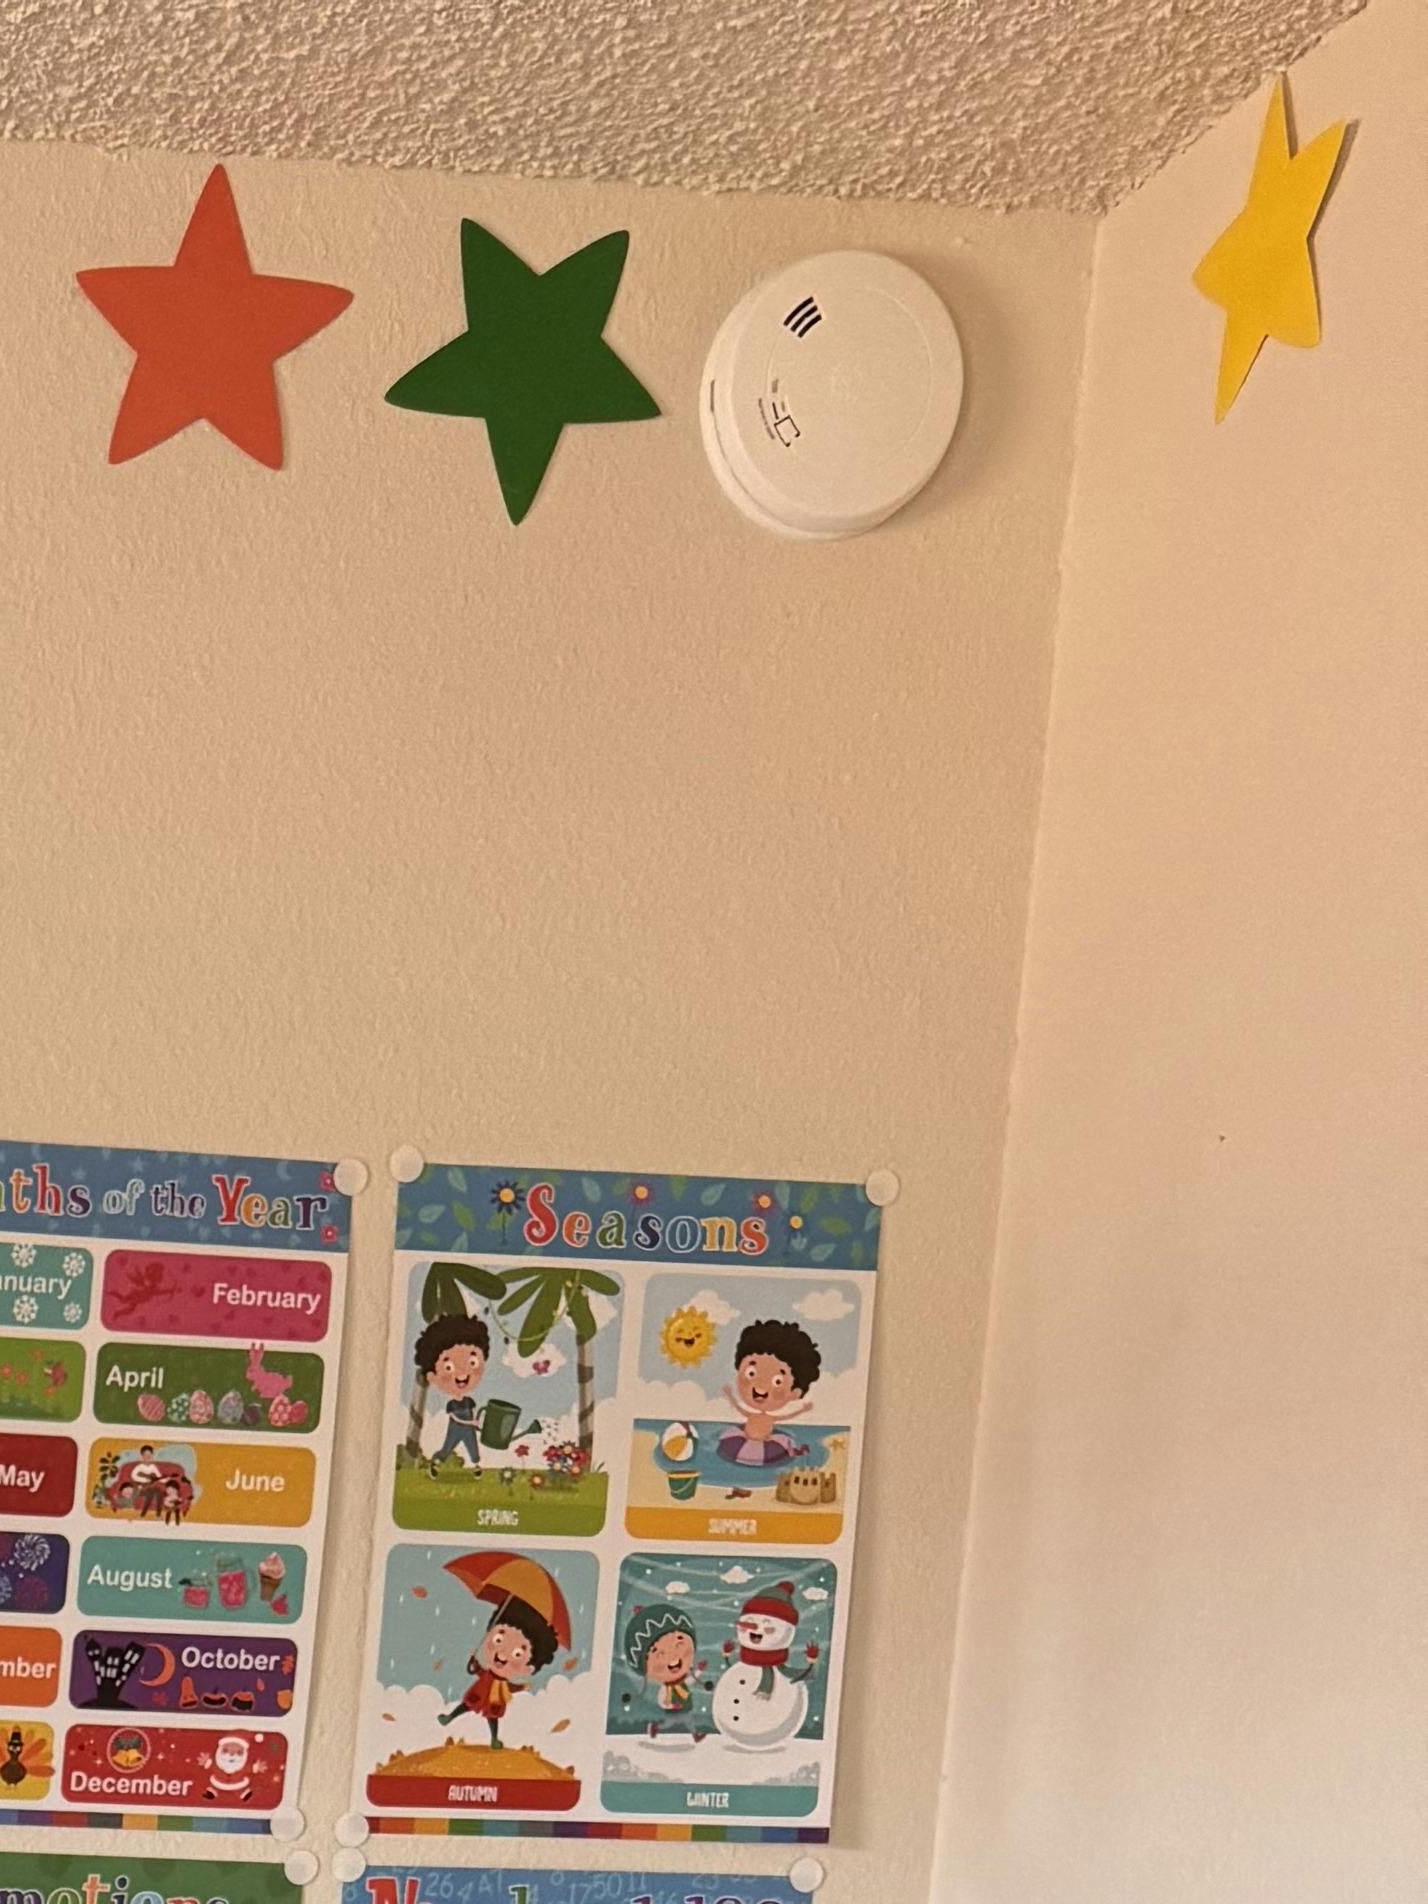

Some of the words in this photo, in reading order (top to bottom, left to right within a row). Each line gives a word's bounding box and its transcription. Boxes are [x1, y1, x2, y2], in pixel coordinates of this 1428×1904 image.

[102, 1179, 144, 1215] of
[150, 1182, 206, 1218] the
[212, 1174, 328, 1230] Year
[523, 1181, 770, 1254] Seasons
[212, 1282, 321, 1313] February
[106, 1366, 164, 1390] April
[225, 1470, 285, 1492] June
[476, 1508, 518, 1526] SPRING
[87, 1564, 173, 1591] August
[181, 1646, 280, 1672] October
[70, 1771, 193, 1796] December
[448, 1784, 498, 1803] AUTUMN
[687, 1790, 730, 1809] WINTER
